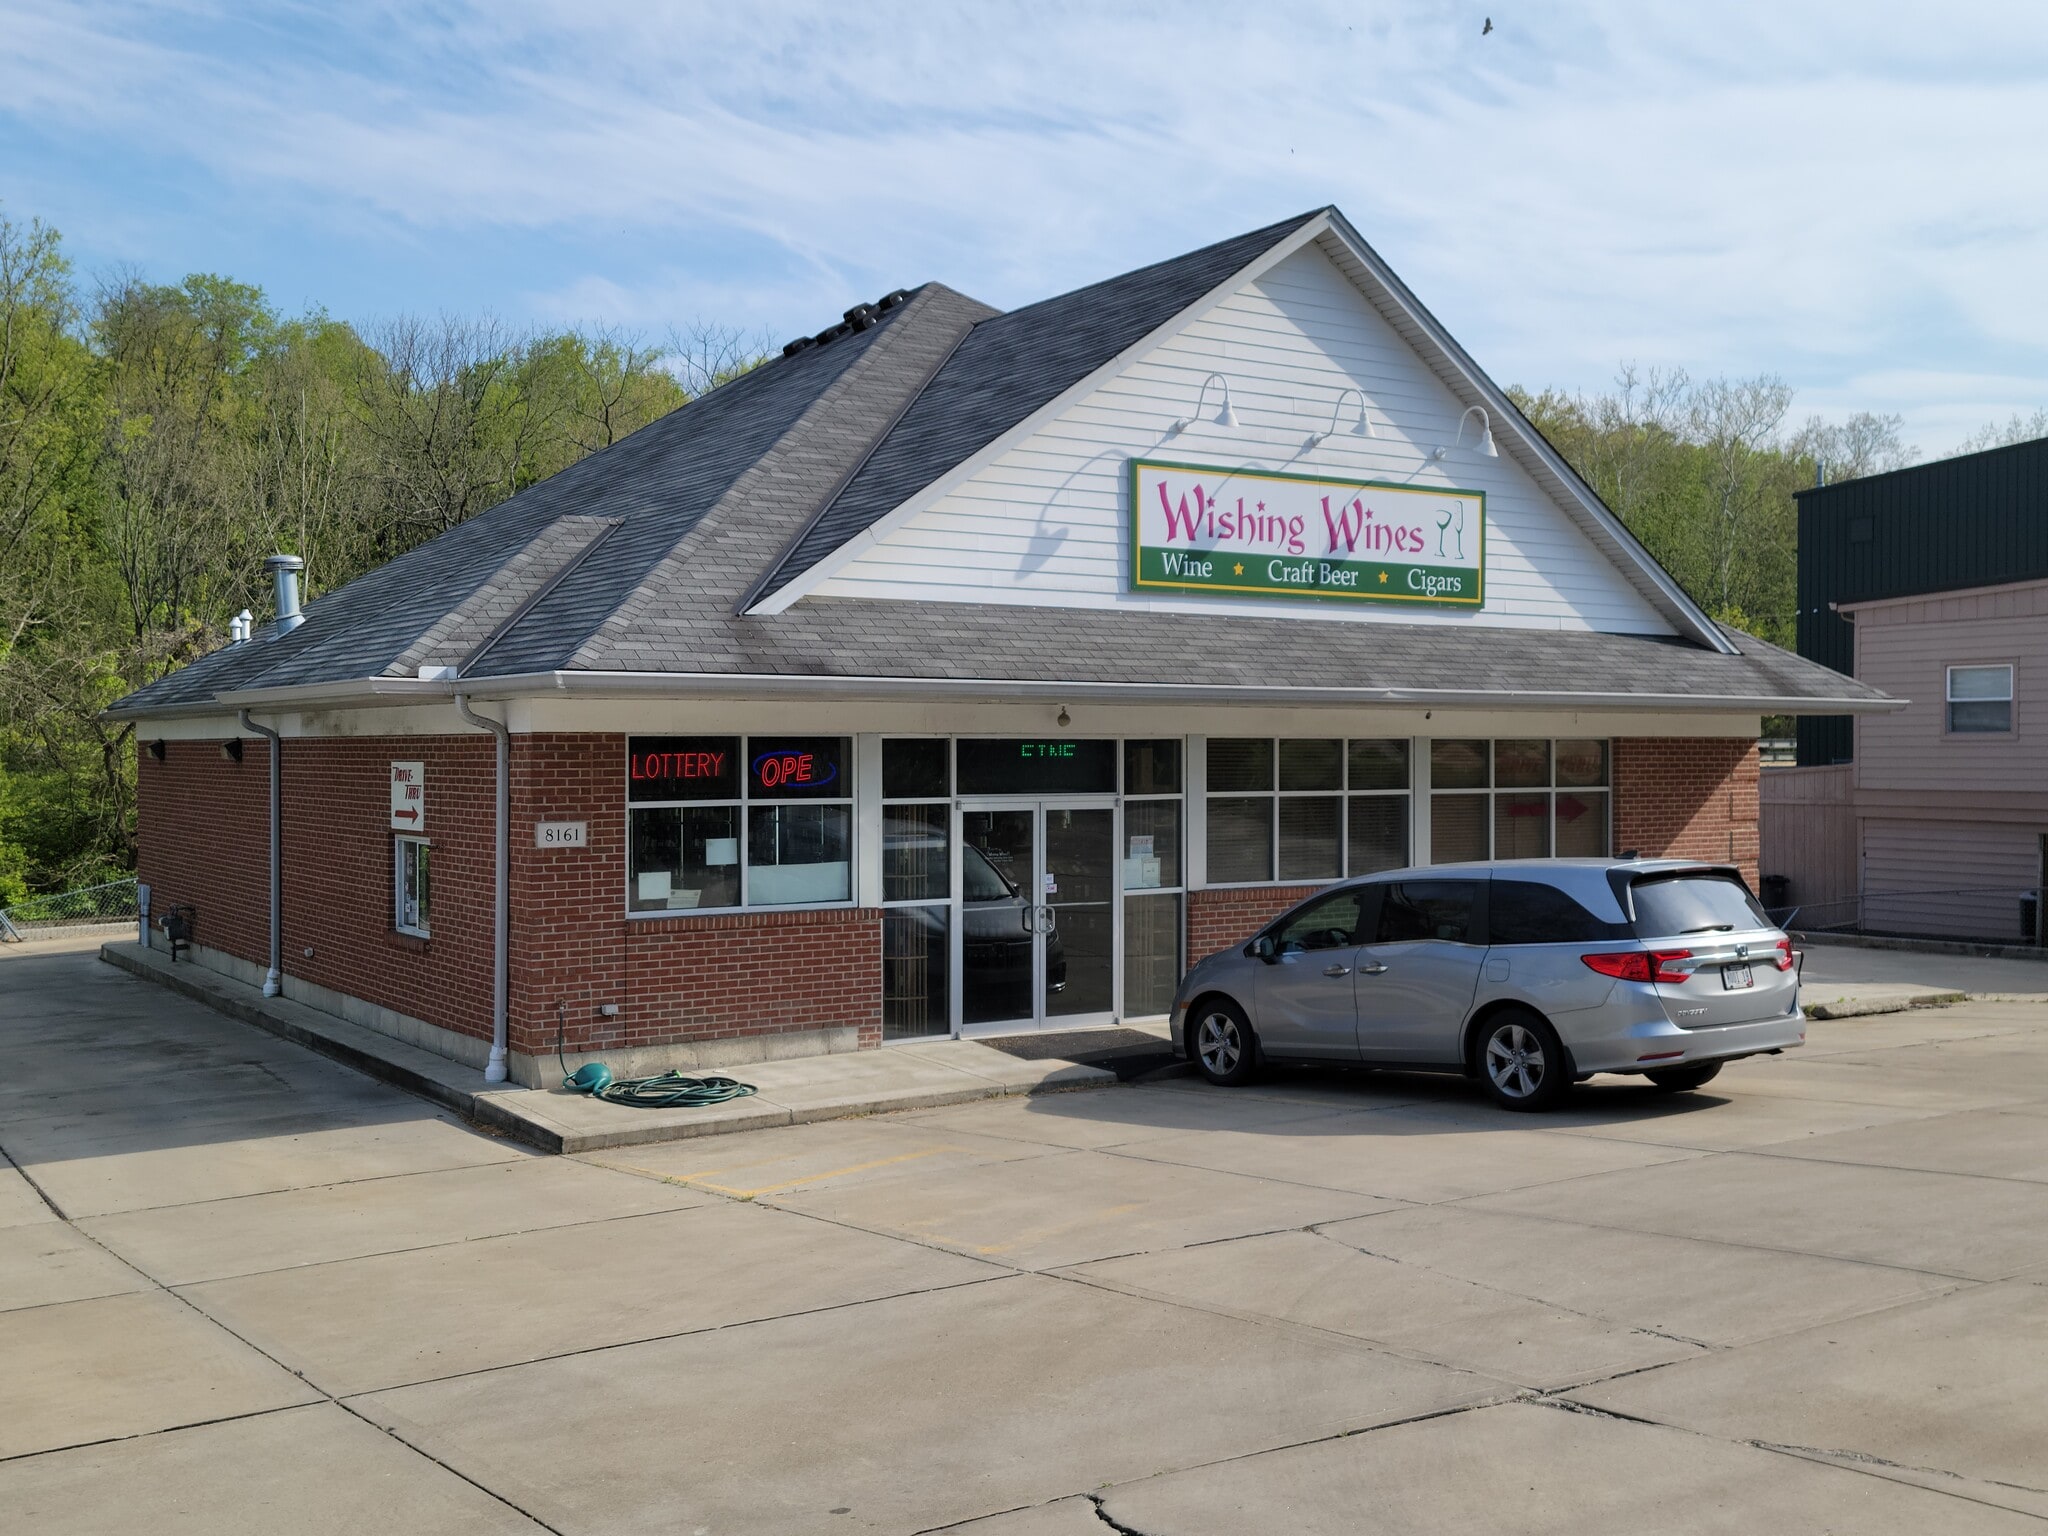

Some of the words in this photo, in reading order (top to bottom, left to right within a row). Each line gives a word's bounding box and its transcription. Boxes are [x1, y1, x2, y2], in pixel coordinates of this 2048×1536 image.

[1157, 480, 1305, 555] Wishing
[1320, 495, 1425, 557] Wines
[1161, 552, 1213, 578] Wine
[1268, 559, 1315, 584] Craft
[1319, 562, 1359, 586] Beer
[1407, 568, 1462, 597] Cigars
[632, 752, 725, 780] LOTTERY
[404, 784, 422, 800] THRU
[545, 828, 579, 842] 8161
